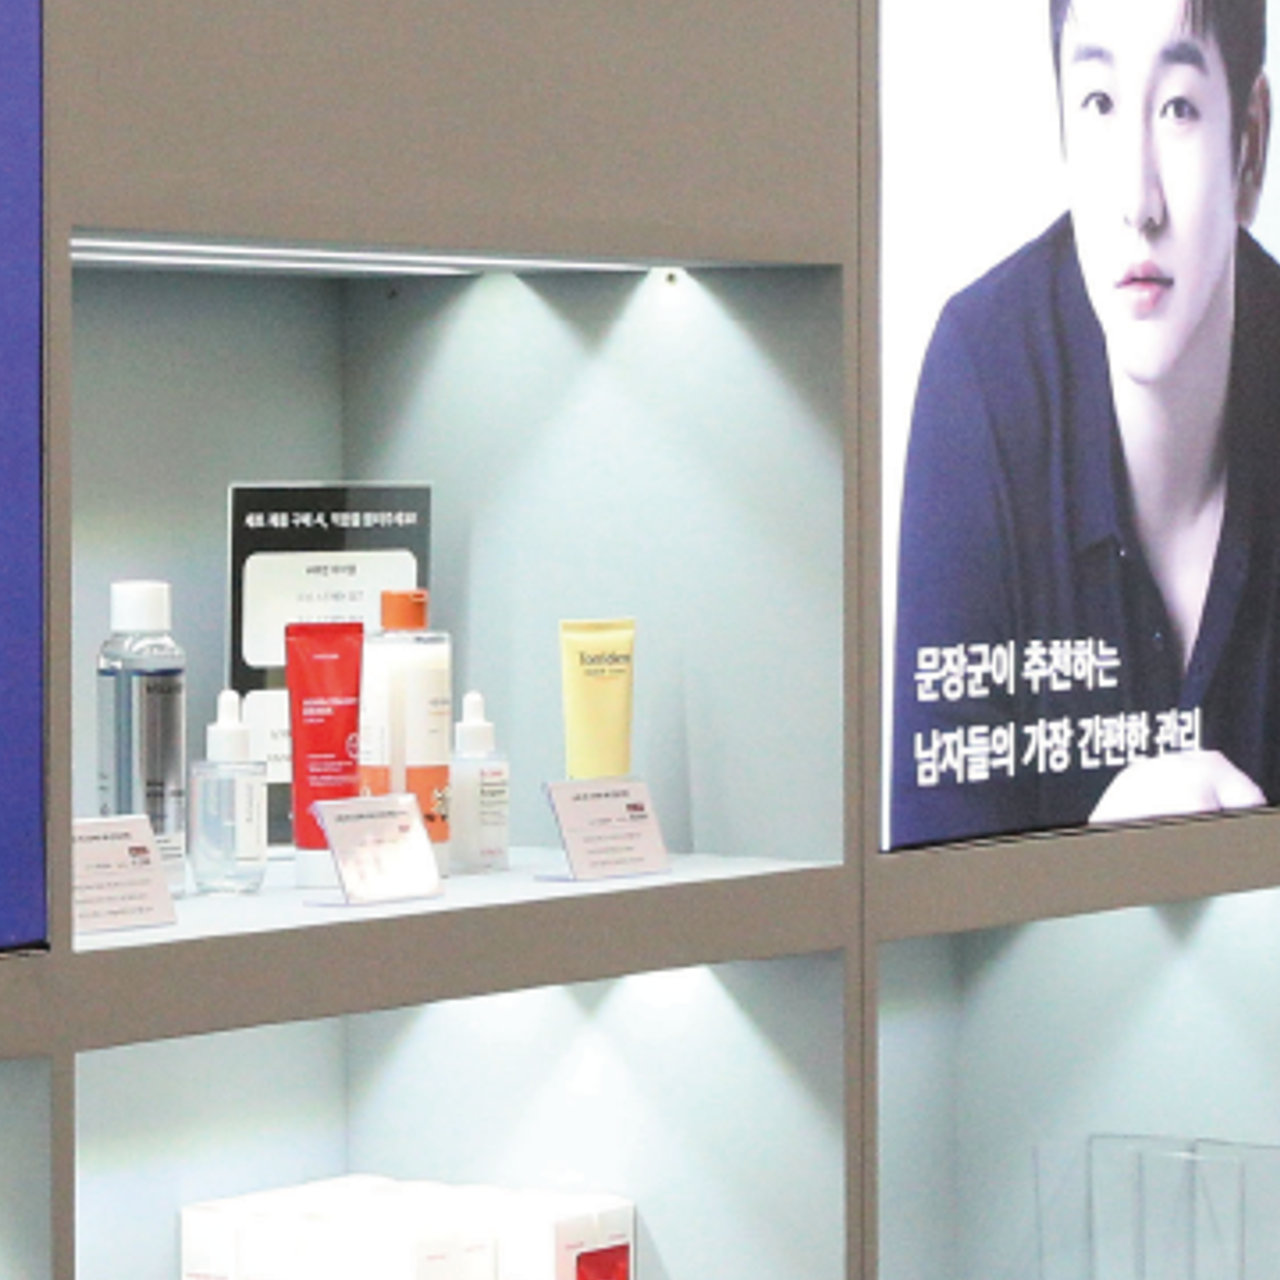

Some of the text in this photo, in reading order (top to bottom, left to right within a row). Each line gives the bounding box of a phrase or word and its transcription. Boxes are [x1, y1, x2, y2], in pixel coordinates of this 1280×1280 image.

[914, 637, 1121, 702] 문장군이 추천하는
[914, 706, 1201, 787] 남자들의 가장 간편한 관리
